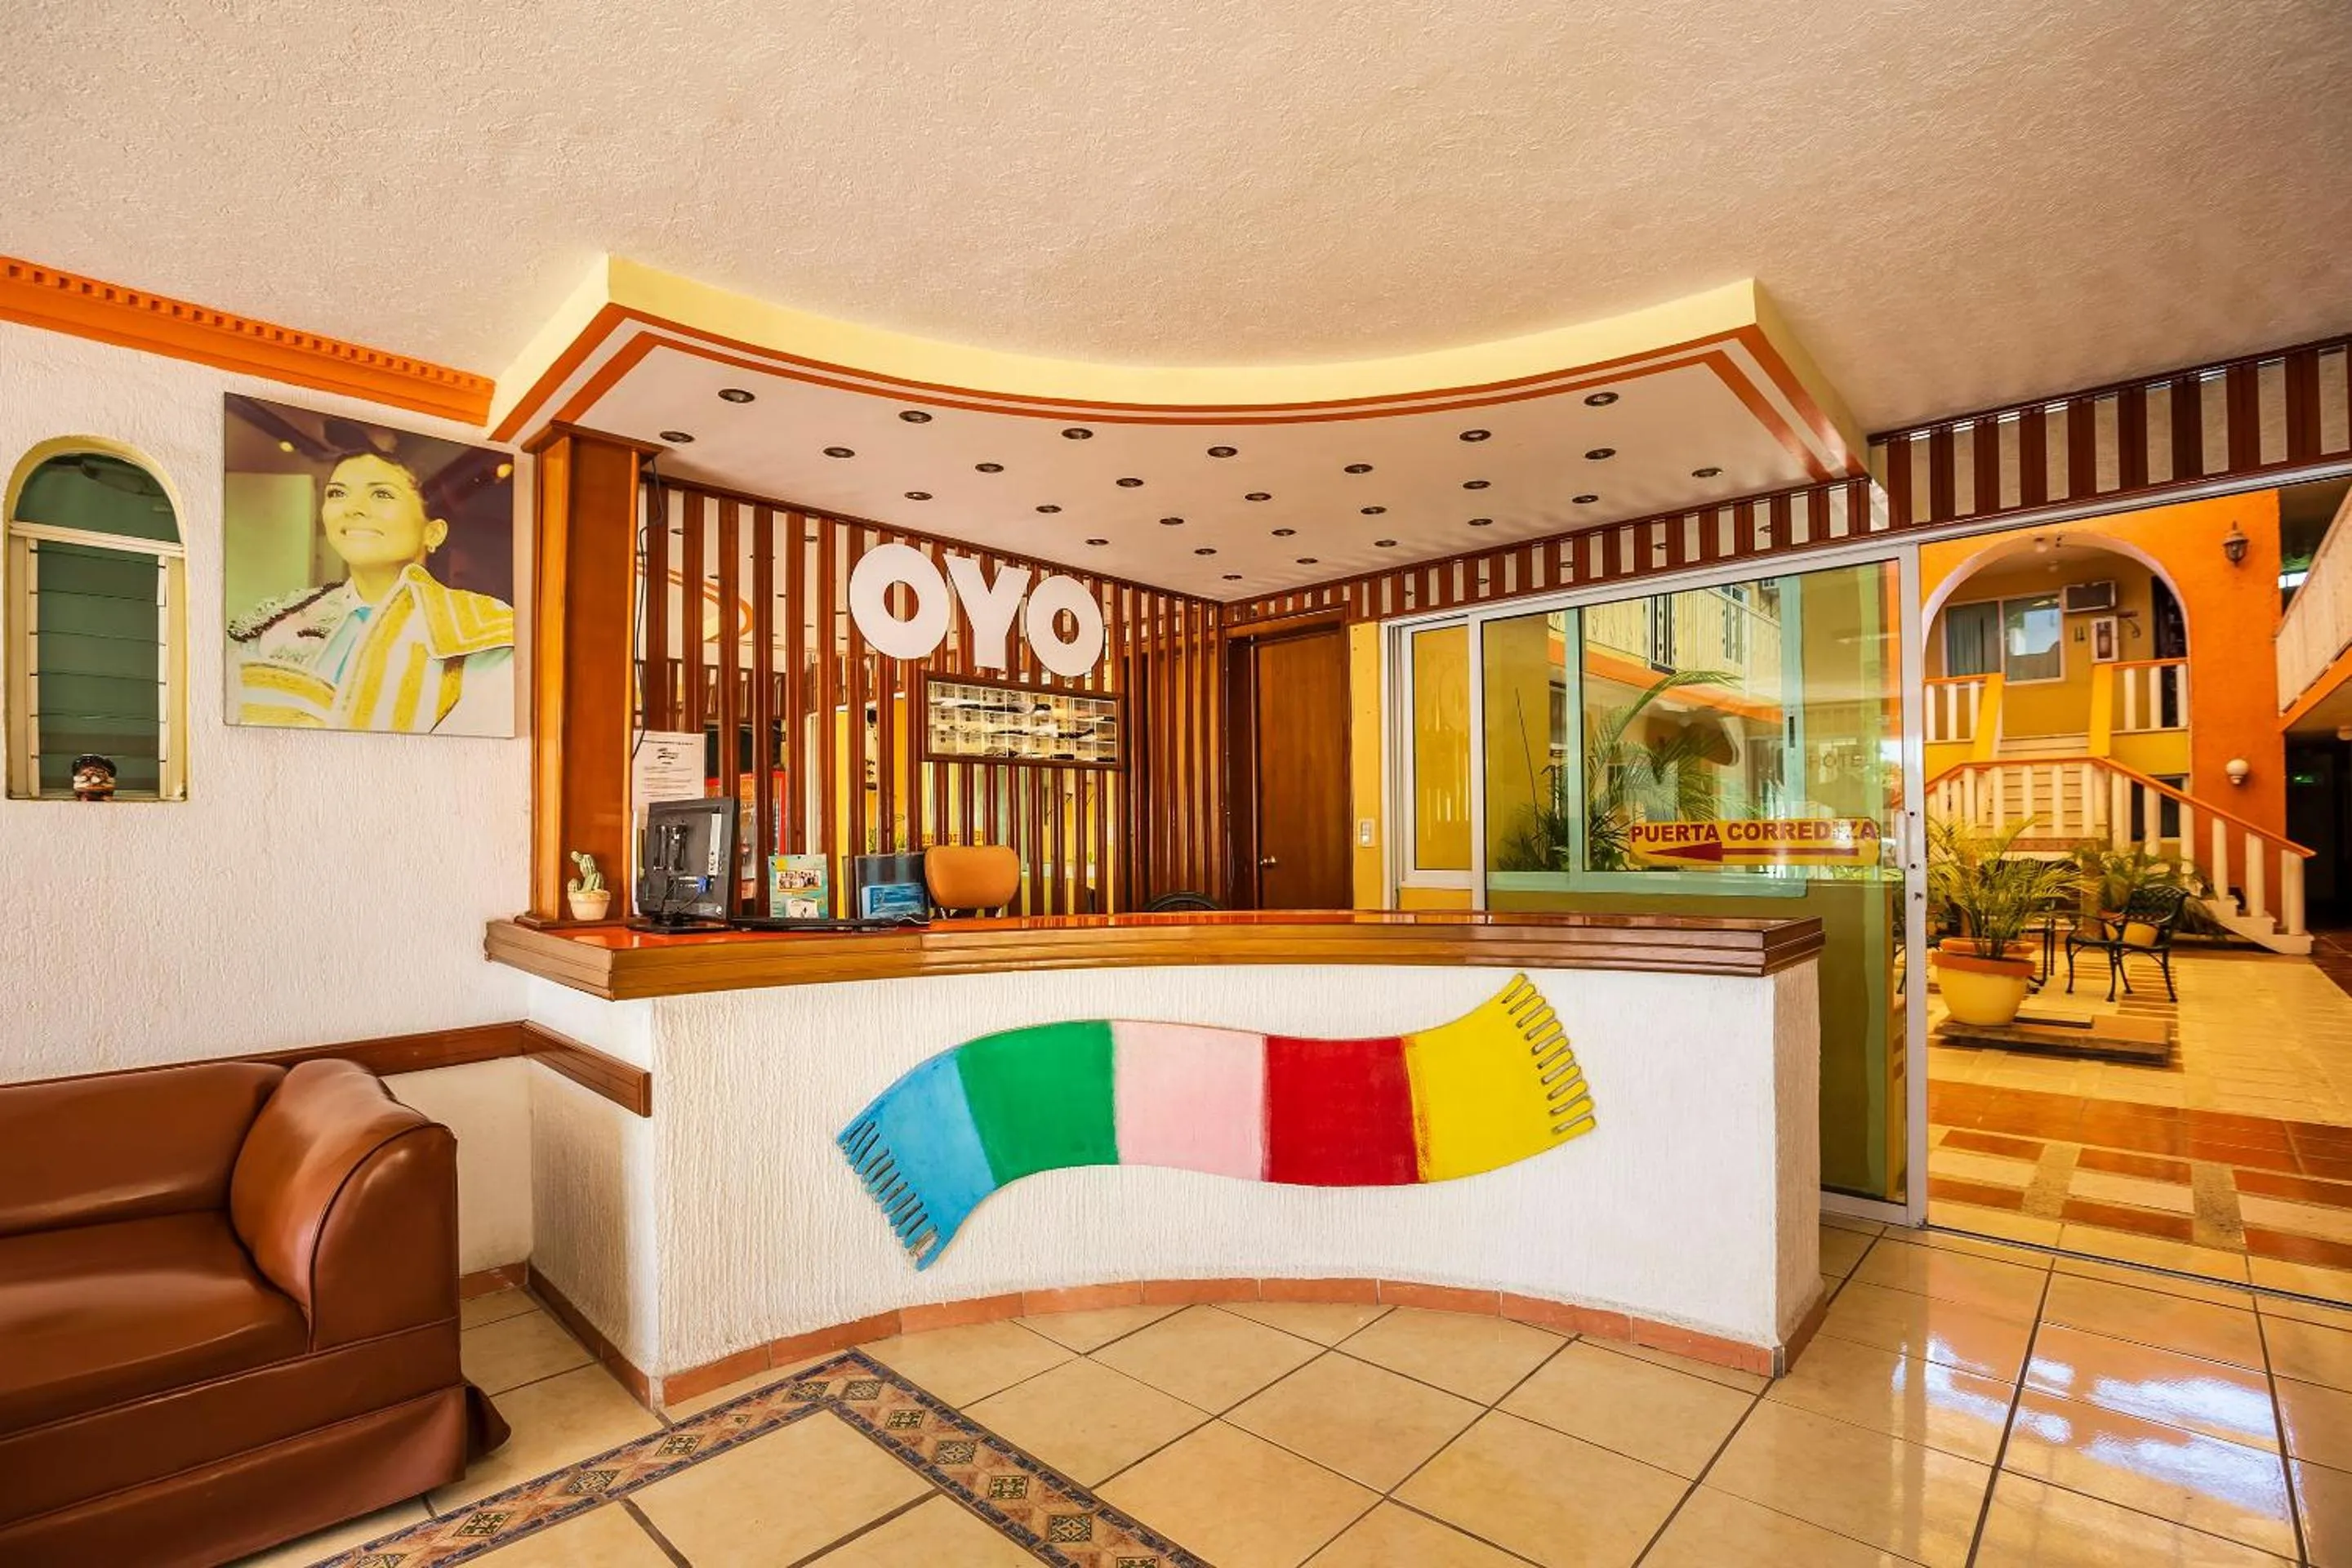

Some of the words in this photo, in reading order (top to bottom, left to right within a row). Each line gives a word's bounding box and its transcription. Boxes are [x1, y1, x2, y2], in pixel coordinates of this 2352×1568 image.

[849, 542, 1104, 677] OYO
[1807, 752, 1870, 769] HOTE
[1631, 823, 1720, 843] PUERTA
